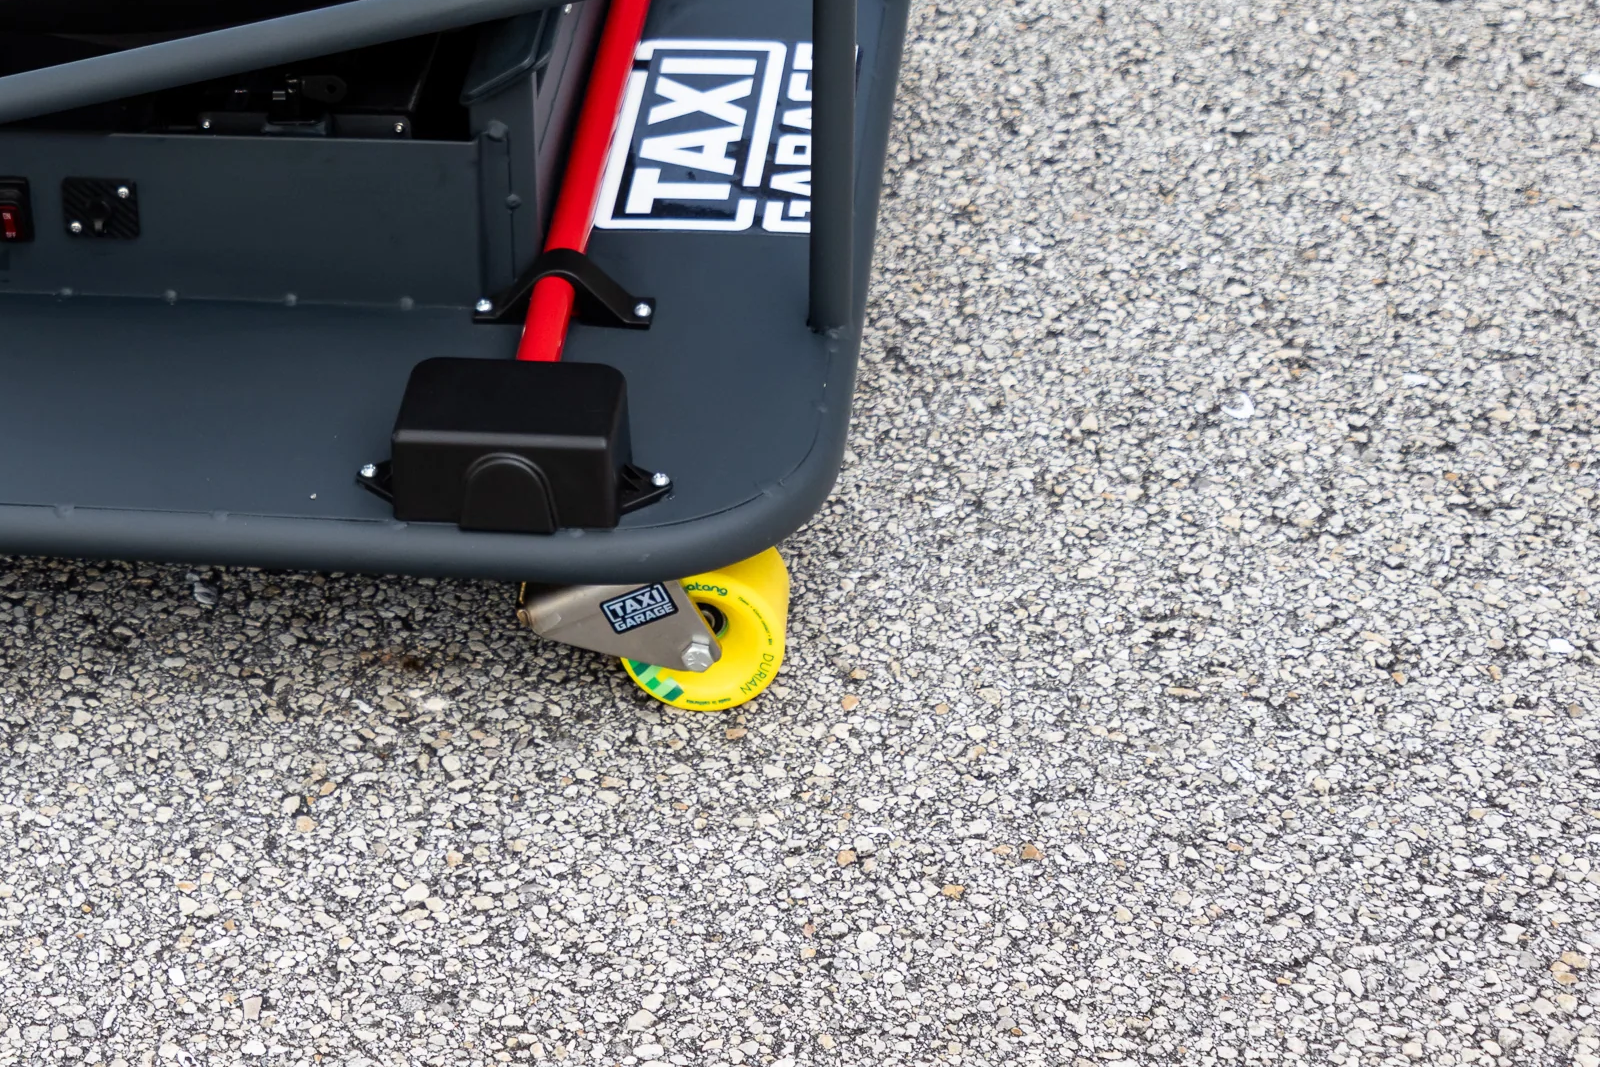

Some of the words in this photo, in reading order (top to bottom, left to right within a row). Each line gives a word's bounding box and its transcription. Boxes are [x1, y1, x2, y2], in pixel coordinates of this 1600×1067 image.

[625, 57, 757, 214] TAXI
[762, 42, 813, 234] GAR
[2, 212, 11, 220] ON
[608, 589, 663, 617] TAXI
[685, 582, 728, 597] atang
[614, 602, 675, 632] GARAGE
[740, 653, 775, 695] DURIAN
